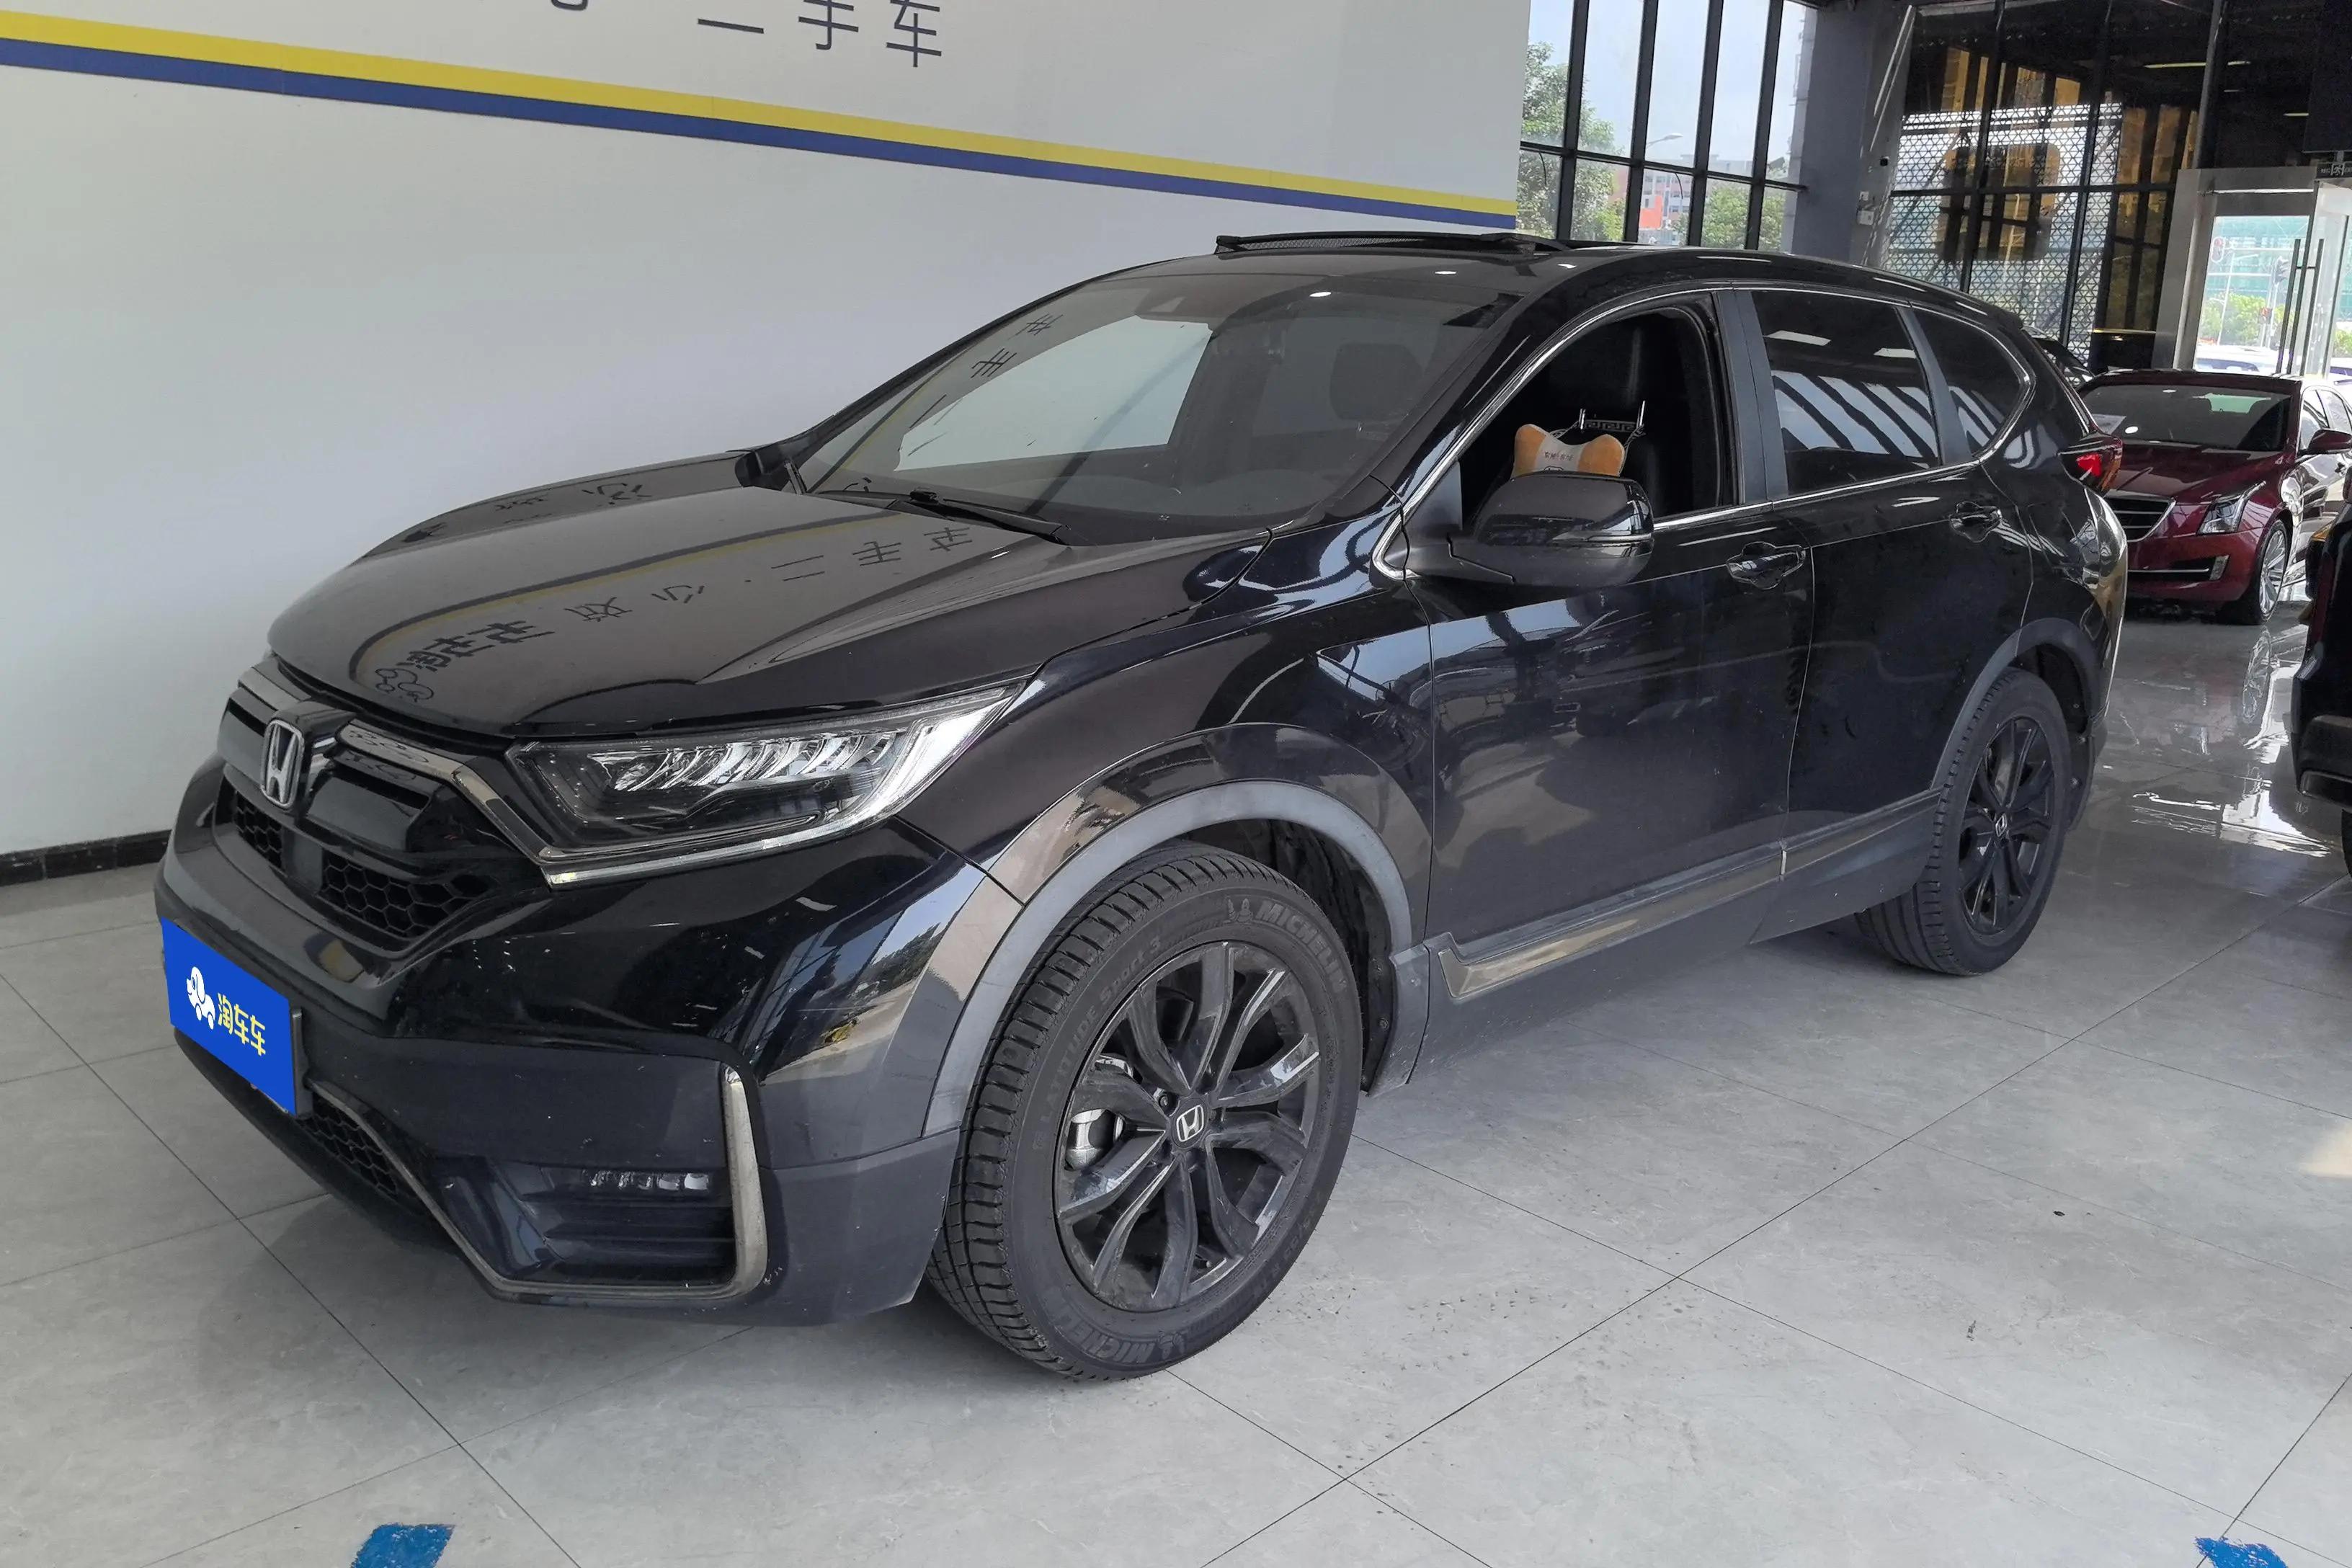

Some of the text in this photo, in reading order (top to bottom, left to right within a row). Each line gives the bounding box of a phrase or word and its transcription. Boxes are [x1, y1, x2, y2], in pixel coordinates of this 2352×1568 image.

[1099, 952, 1147, 1007] Sport
[1149, 935, 1162, 955] 3
[1255, 899, 1348, 994] MICHELIN
